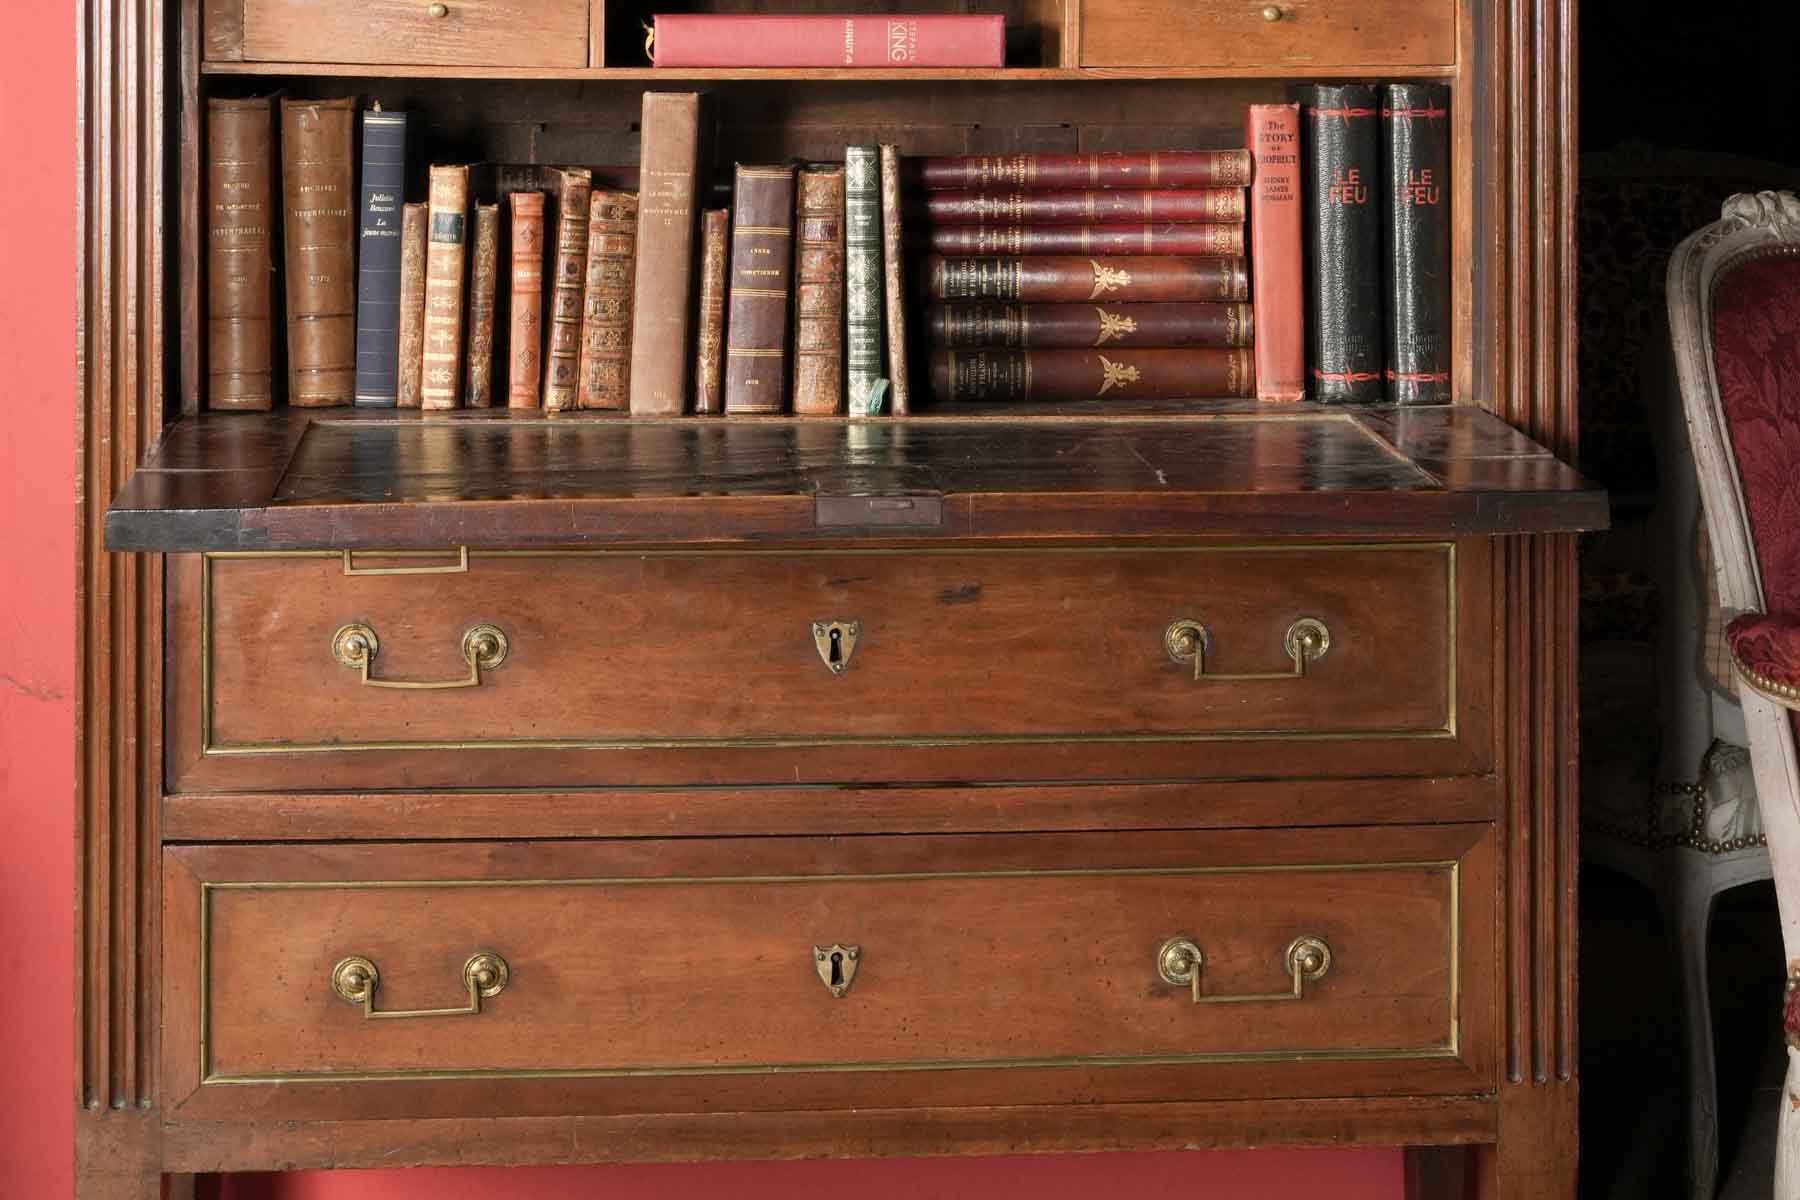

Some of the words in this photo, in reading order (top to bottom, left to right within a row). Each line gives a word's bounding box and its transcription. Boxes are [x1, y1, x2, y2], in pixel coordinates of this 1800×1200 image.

[891, 21, 908, 62] KING
[1268, 121, 1285, 130] The
[1334, 168, 1360, 185] LE
[1408, 168, 1432, 185] LE
[1329, 186, 1367, 204] FEU
[1401, 186, 1440, 205] FEU
